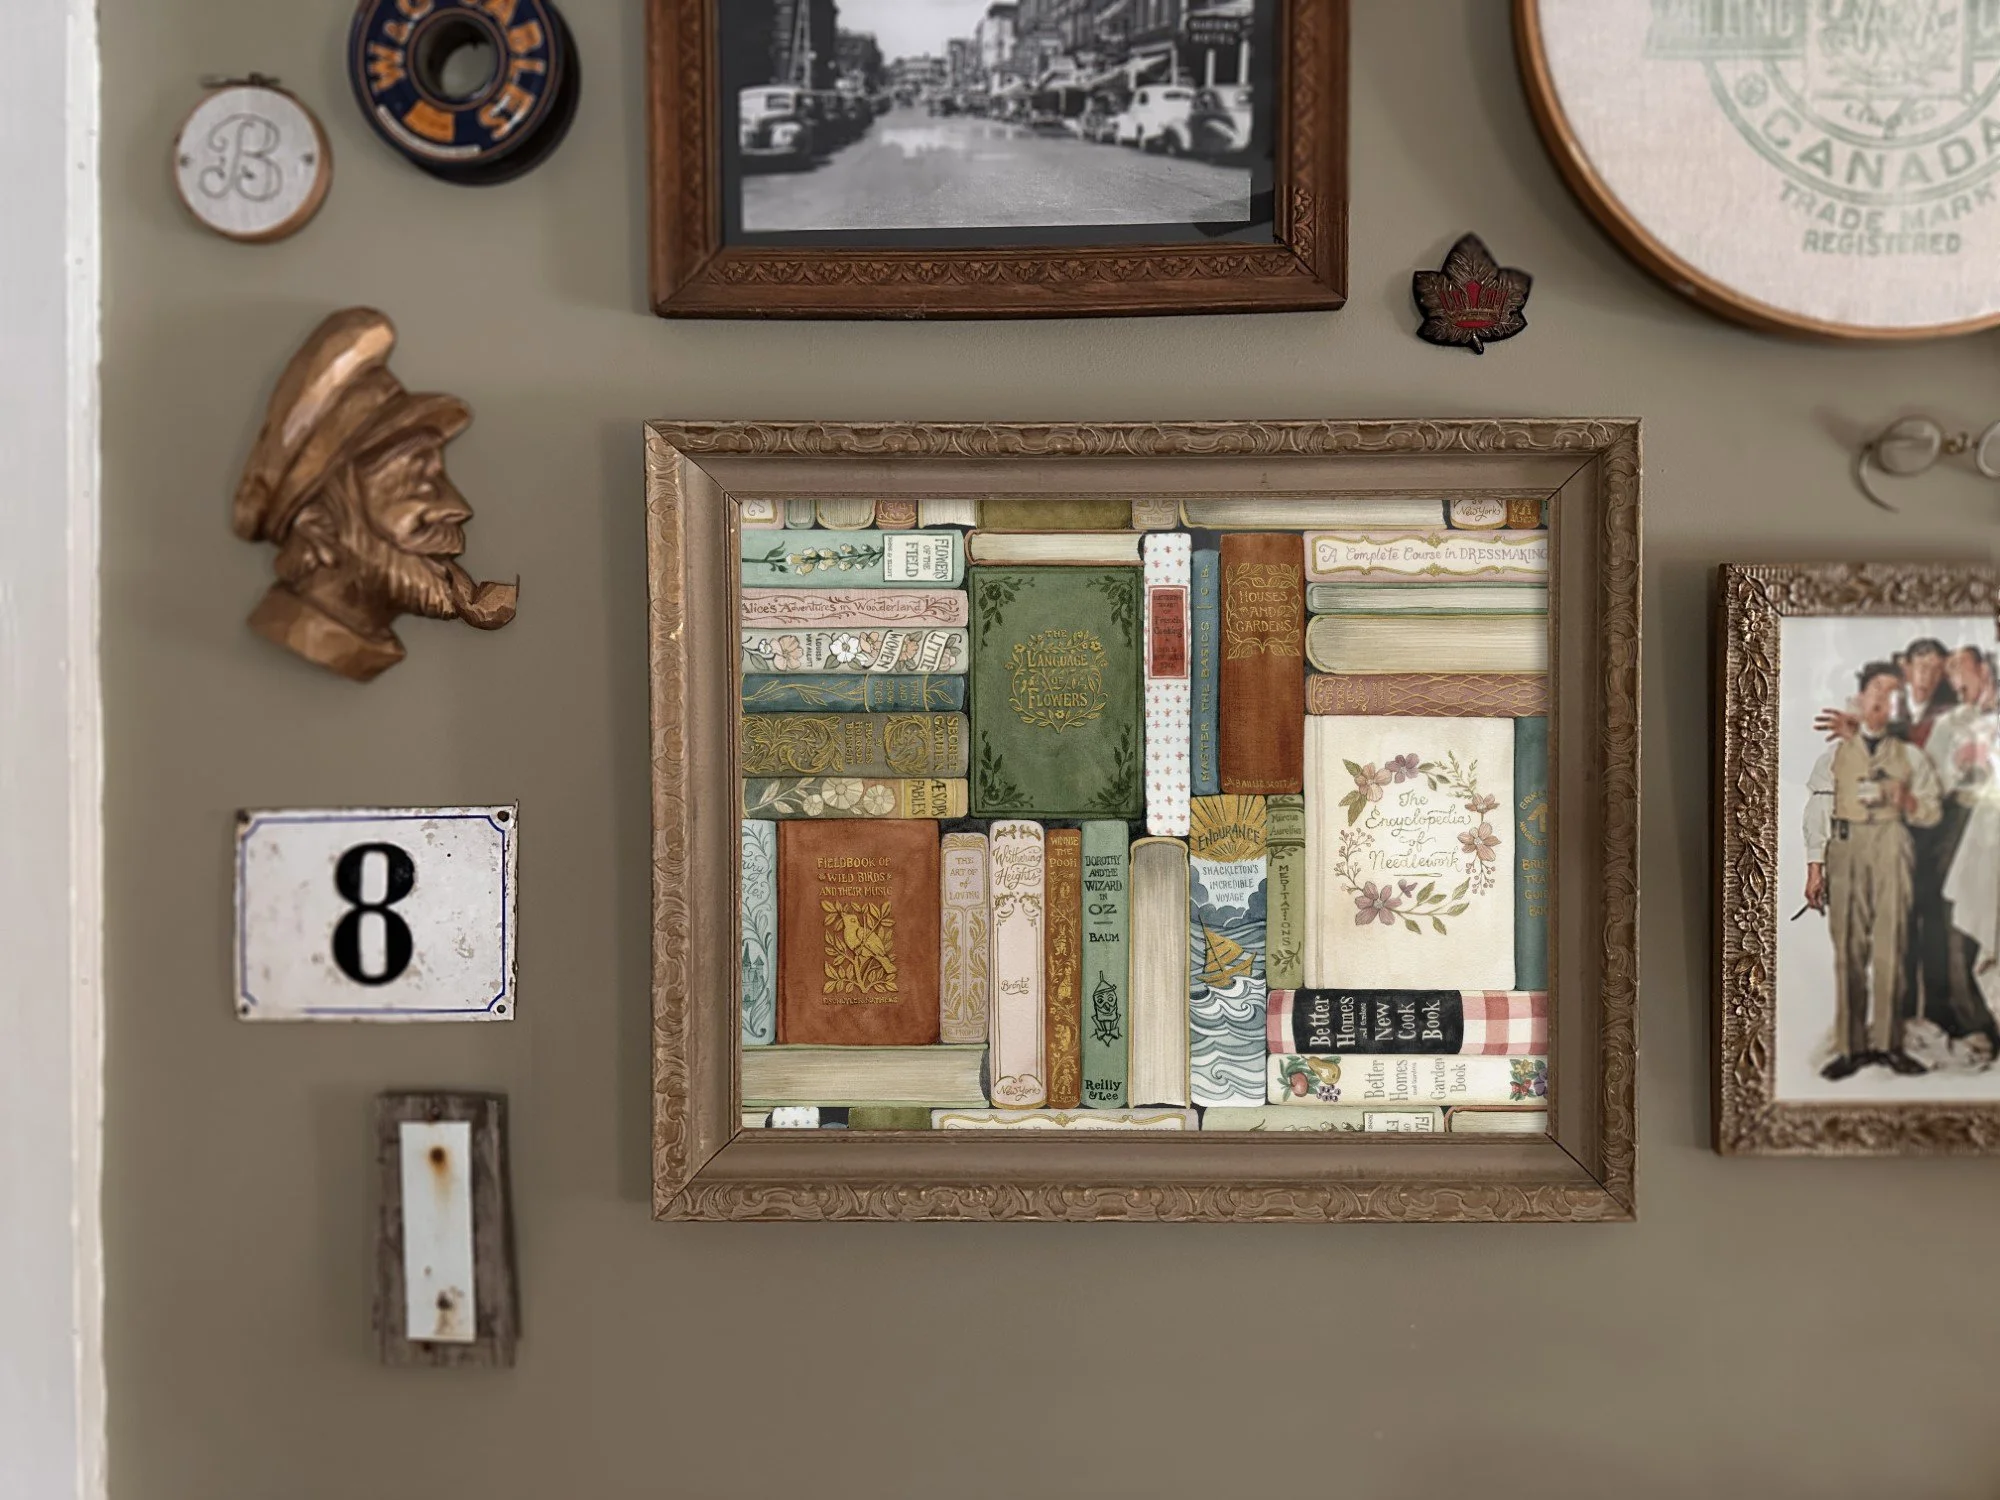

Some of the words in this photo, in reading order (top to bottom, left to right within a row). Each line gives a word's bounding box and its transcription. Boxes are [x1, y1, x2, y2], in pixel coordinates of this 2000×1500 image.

[1779, 179, 1885, 234] TRADE
[1900, 180, 1998, 230] MARK
[1802, 229, 1963, 256] REGISTERED
[905, 542, 919, 578] FIELD
[923, 544, 931, 556] OF
[933, 538, 949, 580] FLOWERS
[1319, 544, 1338, 563] A
[1346, 546, 1400, 565] Complete
[1403, 546, 1441, 561] Course
[1444, 547, 1458, 559] in
[1459, 547, 1548, 564] DRESSMAKING
[780, 601, 836, 614] Adventures
[854, 599, 922, 614] Wonderland
[1239, 590, 1288, 603] HOUSES
[1250, 606, 1276, 617] AND
[1045, 629, 1067, 638] THE
[1236, 620, 1292, 632] GARDENS
[876, 634, 903, 669] WOMEN
[919, 632, 946, 671] LITTLE
[1202, 684, 1211, 714] THE
[933, 715, 945, 772] GARDEN
[947, 716, 958, 771] SECRET
[1201, 722, 1210, 782] MASTER
[910, 780, 926, 816] FABLES
[1399, 789, 1429, 807] The
[1365, 805, 1472, 836] Encyclopedia
[1050, 836, 1079, 846] WINNIE
[1198, 823, 1261, 852] ENDURANCE
[878, 856, 892, 866] OF
[1055, 848, 1073, 856] THE
[1084, 855, 1122, 866] DOROTHY
[1369, 847, 1463, 872] Needlework
[827, 872, 854, 883] WILD
[857, 871, 886, 883] BIRDS
[995, 867, 1042, 890] Heights
[1088, 868, 1104, 877] AND
[1104, 868, 1118, 877] THE
[1202, 864, 1259, 876] SHACKLETON'S
[820, 886, 836, 896] AND
[837, 886, 862, 896] THEIR
[864, 886, 893, 896] MUSIC
[1084, 880, 1122, 891] WIZARD
[1215, 893, 1245, 902] VOYAGE
[330, 841, 415, 986] 8
[1088, 904, 1117, 915] OZ
[1088, 932, 1120, 942] BAUM
[1308, 995, 1331, 1047] Better
[1336, 996, 1356, 1048] Homes
[1374, 1001, 1394, 1041] New
[1397, 1002, 1417, 1040] Cook
[1421, 999, 1443, 1041] Book
[1085, 1079, 1122, 1091] Reilly
[1363, 1059, 1386, 1099] Better
[1389, 1059, 1409, 1101] Homes
[1430, 1057, 1446, 1101] Garden
[1449, 1063, 1467, 1093] Book
